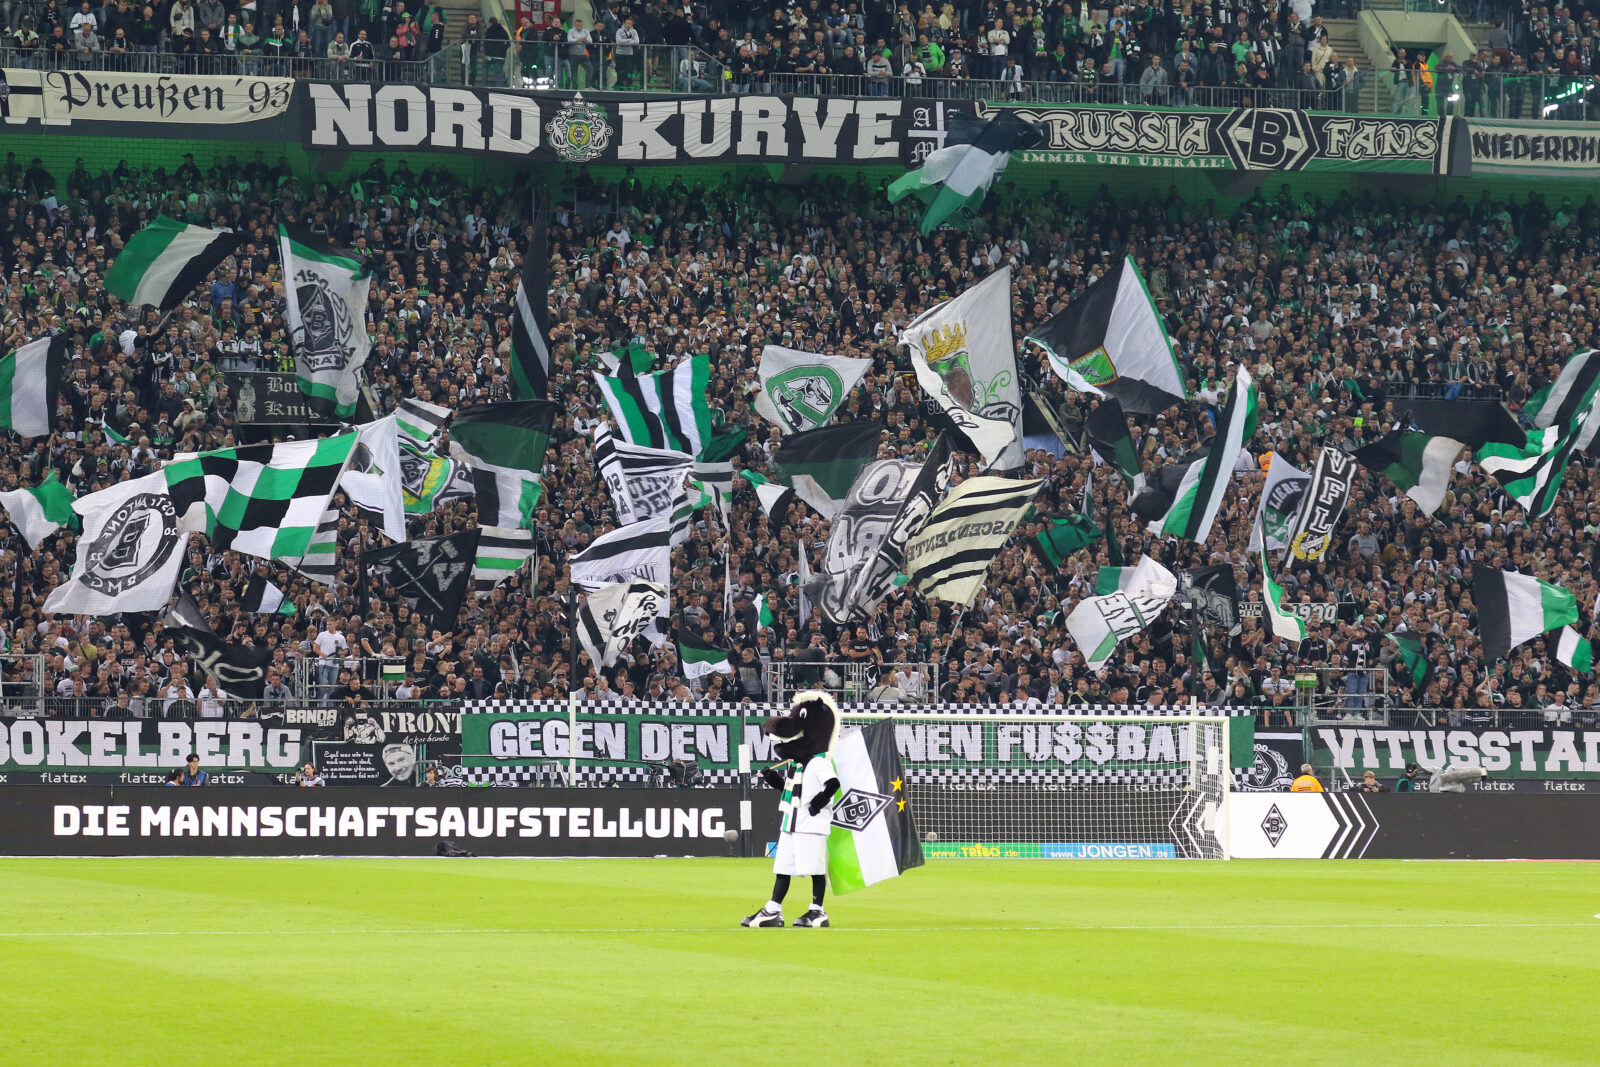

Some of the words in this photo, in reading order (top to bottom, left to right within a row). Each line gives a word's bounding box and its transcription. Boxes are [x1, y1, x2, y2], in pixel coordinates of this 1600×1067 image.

[47, 71, 225, 118] Preußen
[308, 83, 541, 154] NORD
[617, 95, 902, 160] KURVE
[983, 108, 1208, 157] RUSSIA
[1323, 119, 1439, 160] FANS
[1471, 131, 1600, 163] NIEDERRH
[1022, 152, 1086, 163] IMMER
[1095, 154, 1130, 166] UND
[286, 709, 337, 723] BANDA
[490, 720, 627, 760] GEGEN
[641, 722, 729, 763] DEN
[40, 772, 87, 783] flatex
[120, 773, 166, 784] flatex
[210, 773, 245, 784] atex
[1543, 780, 1586, 791] flatex
[53, 805, 130, 837] DIE
[140, 805, 726, 838] MANNSCHAFTSAUFSTELLUNG
[1079, 845, 1151, 858] JONGEN
